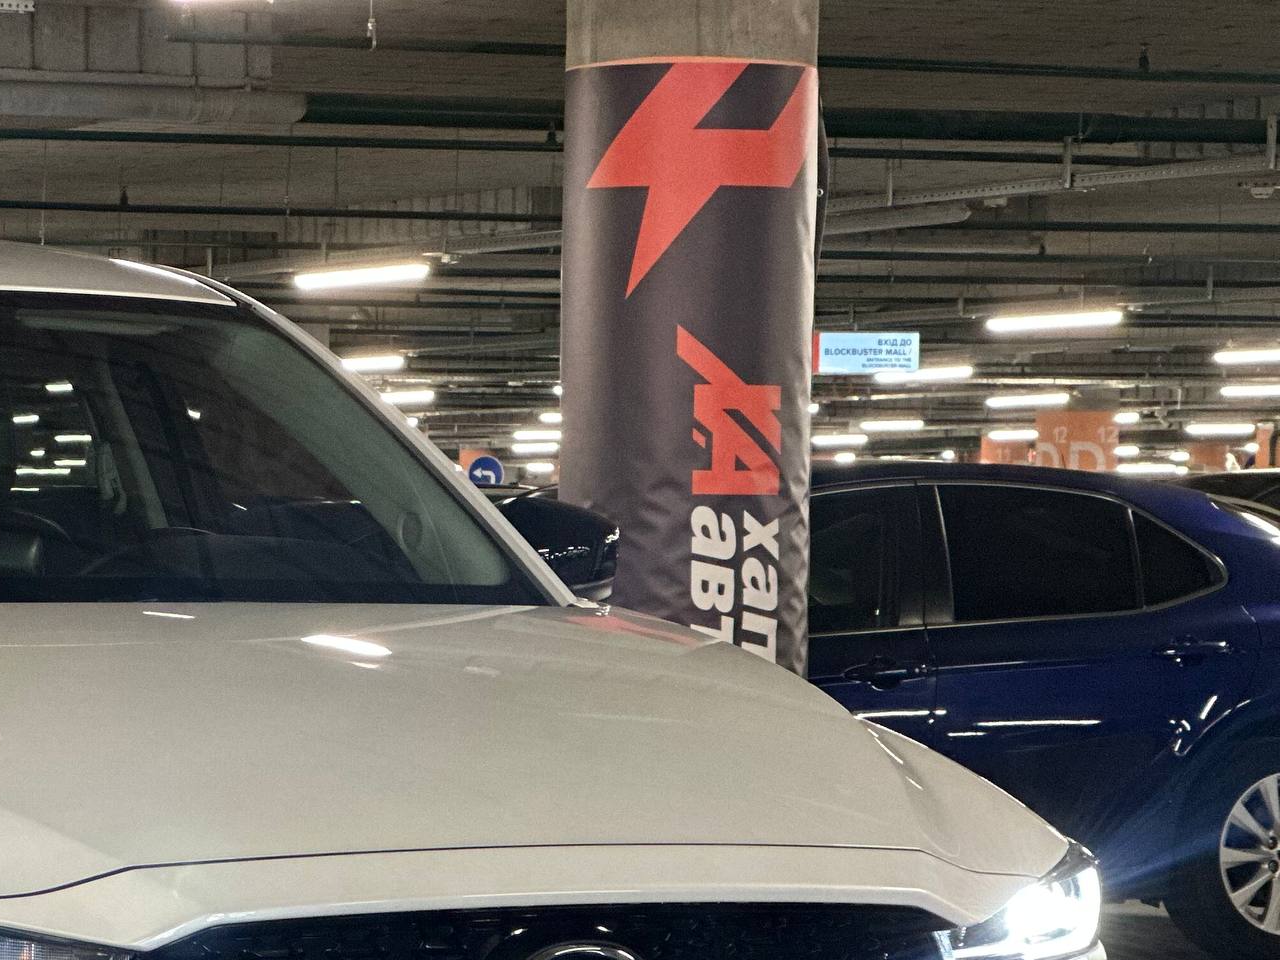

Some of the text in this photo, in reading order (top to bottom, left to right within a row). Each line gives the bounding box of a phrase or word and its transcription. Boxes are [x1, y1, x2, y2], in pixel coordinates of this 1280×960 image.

[877, 338, 912, 347] ВХІД ДО
[824, 348, 883, 356] BLOCKBUSTER
[885, 348, 906, 356] MALL
[1052, 426, 1067, 443] 12
[1097, 425, 1119, 443] 12
